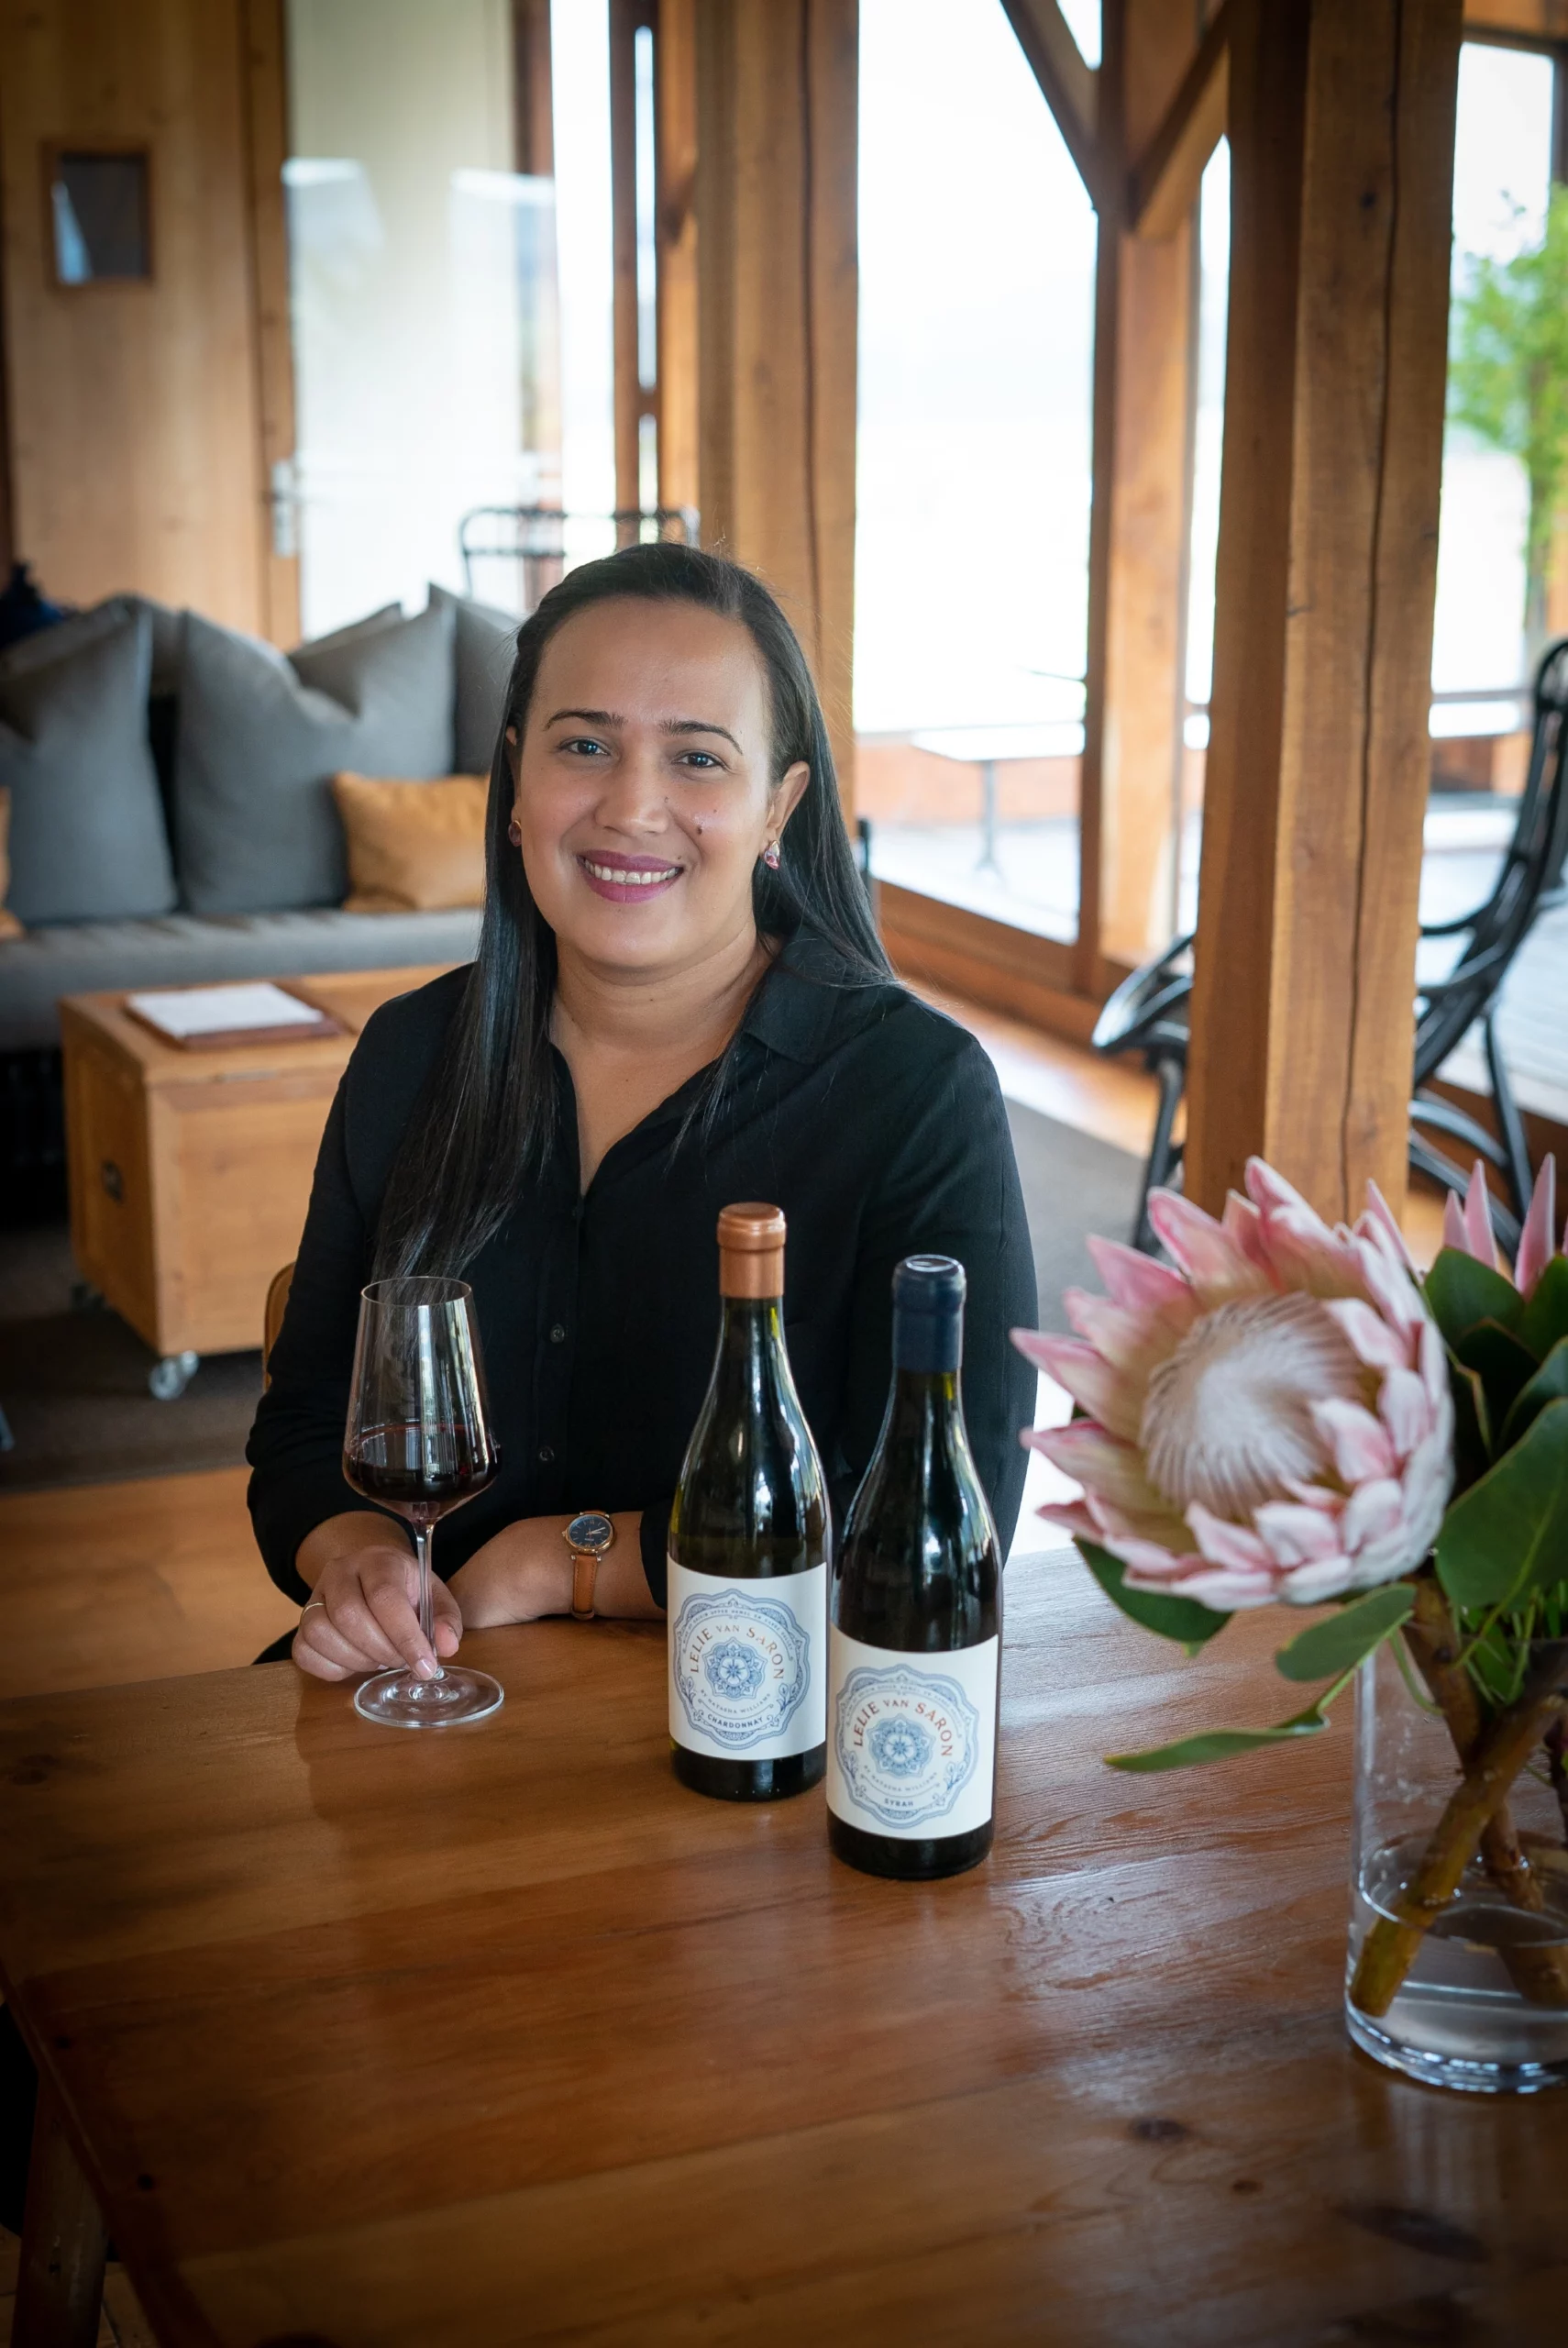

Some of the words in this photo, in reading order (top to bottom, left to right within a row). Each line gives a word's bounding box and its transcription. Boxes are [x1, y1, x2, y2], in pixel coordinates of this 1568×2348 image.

[690, 1627, 713, 1674] LELIE
[715, 1624, 741, 1634] VAN
[745, 1626, 785, 1680] SARON
[707, 1698, 738, 1714] NATASHA
[740, 1692, 771, 1713] WILLIAMS
[707, 1713, 764, 1729] CHARDONNAY
[852, 1701, 880, 1749] LELIE
[882, 1699, 910, 1709] VAN
[914, 1701, 954, 1757] SARON
[884, 1798, 914, 1807] SYRAH
